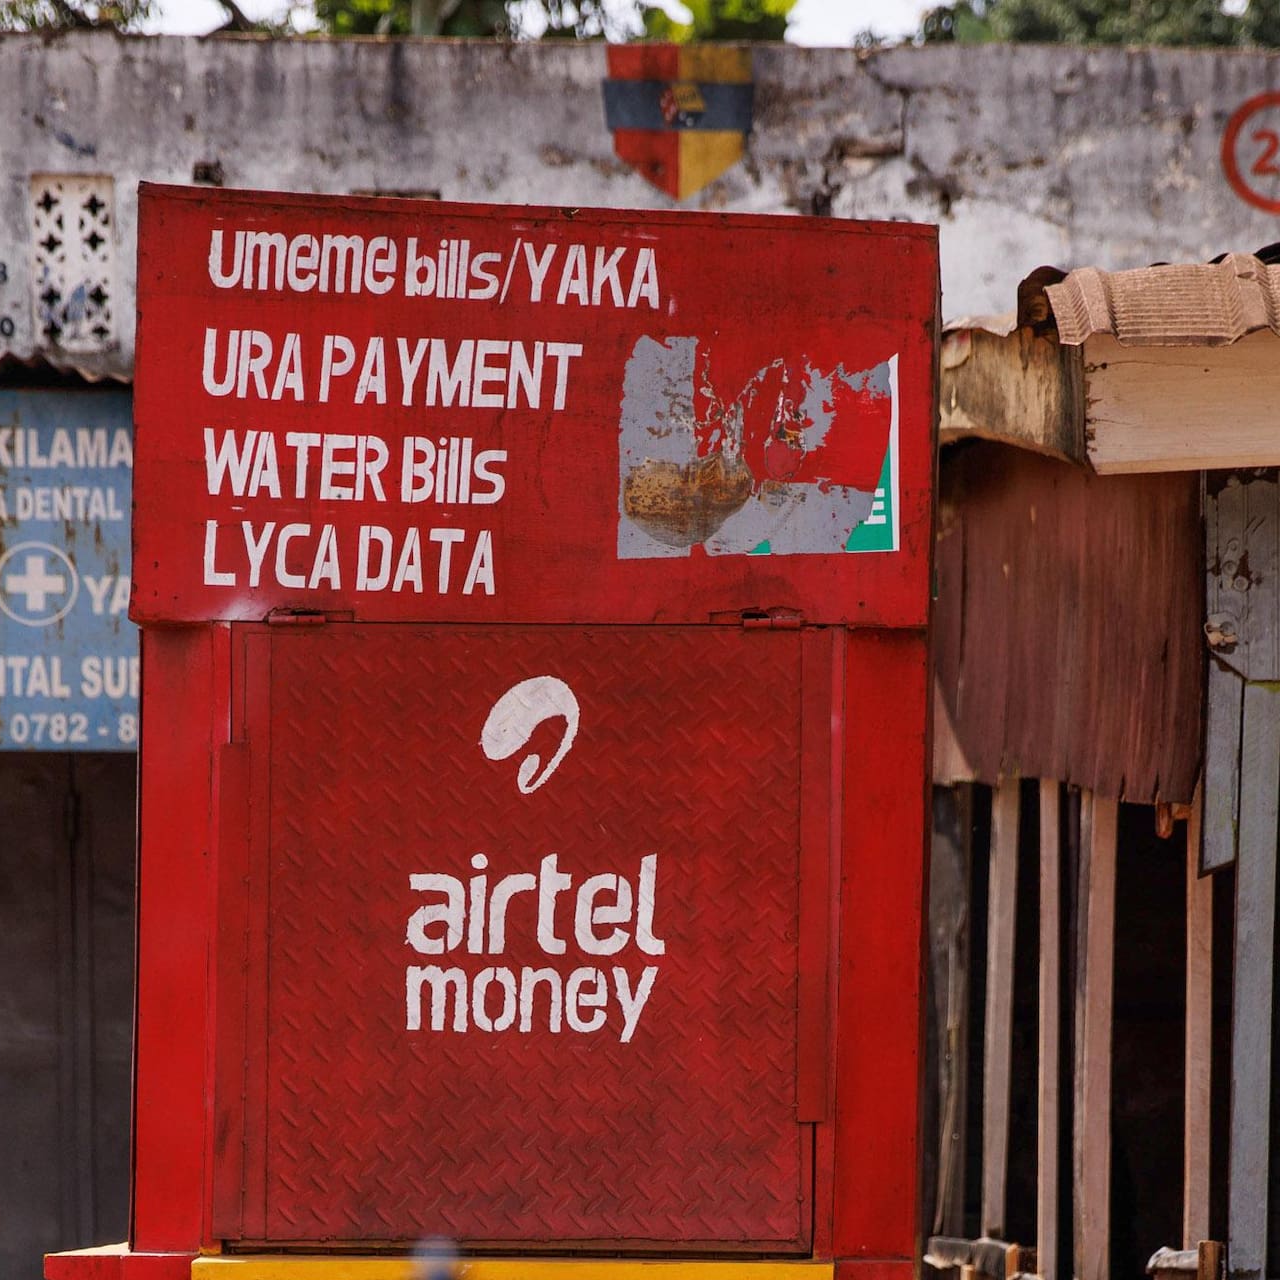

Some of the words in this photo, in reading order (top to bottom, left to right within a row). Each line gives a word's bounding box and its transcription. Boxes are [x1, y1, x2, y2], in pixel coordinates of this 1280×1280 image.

[208, 229, 397, 296] Umeme
[202, 328, 304, 402] URA
[319, 334, 584, 410] PAYMENT
[16, 486, 123, 521] DENTAL
[203, 427, 390, 502] WATER
[401, 436, 508, 505] Bills
[10, 713, 88, 743] 0782
[405, 853, 665, 955] airtel
[405, 965, 659, 1042] money
